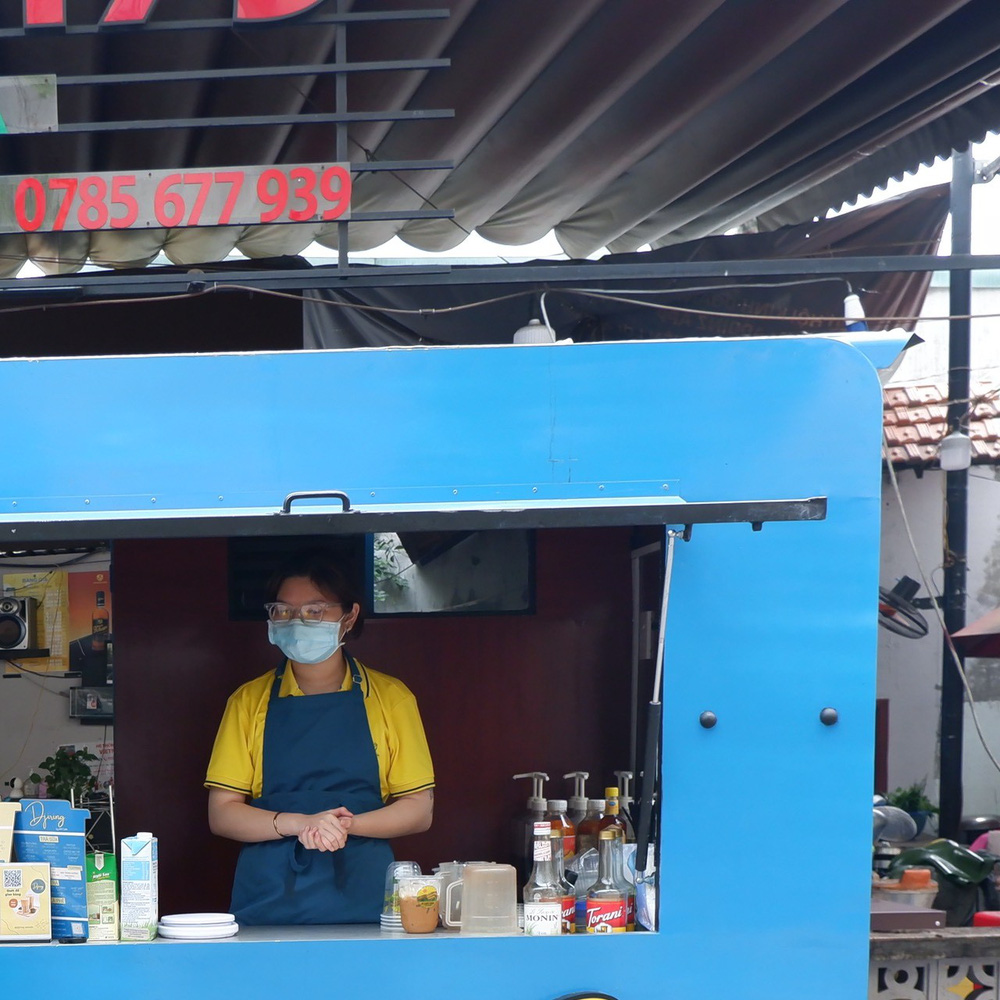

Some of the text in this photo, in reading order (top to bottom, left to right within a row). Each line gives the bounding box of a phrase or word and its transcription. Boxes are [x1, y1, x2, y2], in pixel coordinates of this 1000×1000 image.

[14, 174, 139, 232] 0785
[154, 171, 245, 228] 677
[256, 165, 353, 223] 939
[526, 914, 559, 922] MONIN
[587, 906, 624, 928] Torani
